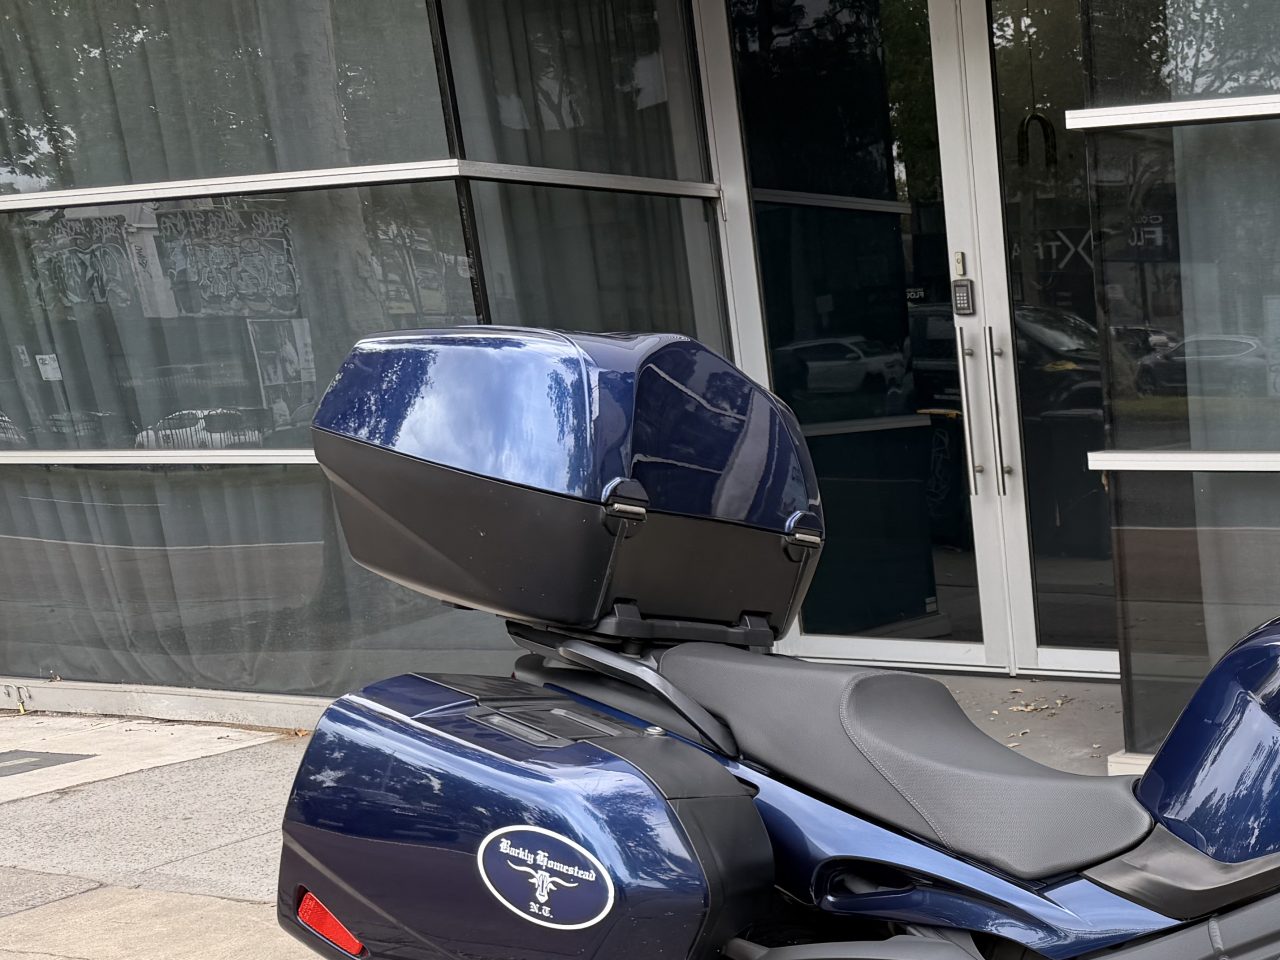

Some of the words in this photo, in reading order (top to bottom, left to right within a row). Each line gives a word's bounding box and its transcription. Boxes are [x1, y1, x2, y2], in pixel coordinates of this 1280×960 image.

[499, 838, 535, 864] Barkly
[535, 850, 597, 881] Homestead
[529, 901, 554, 919] N.T.
